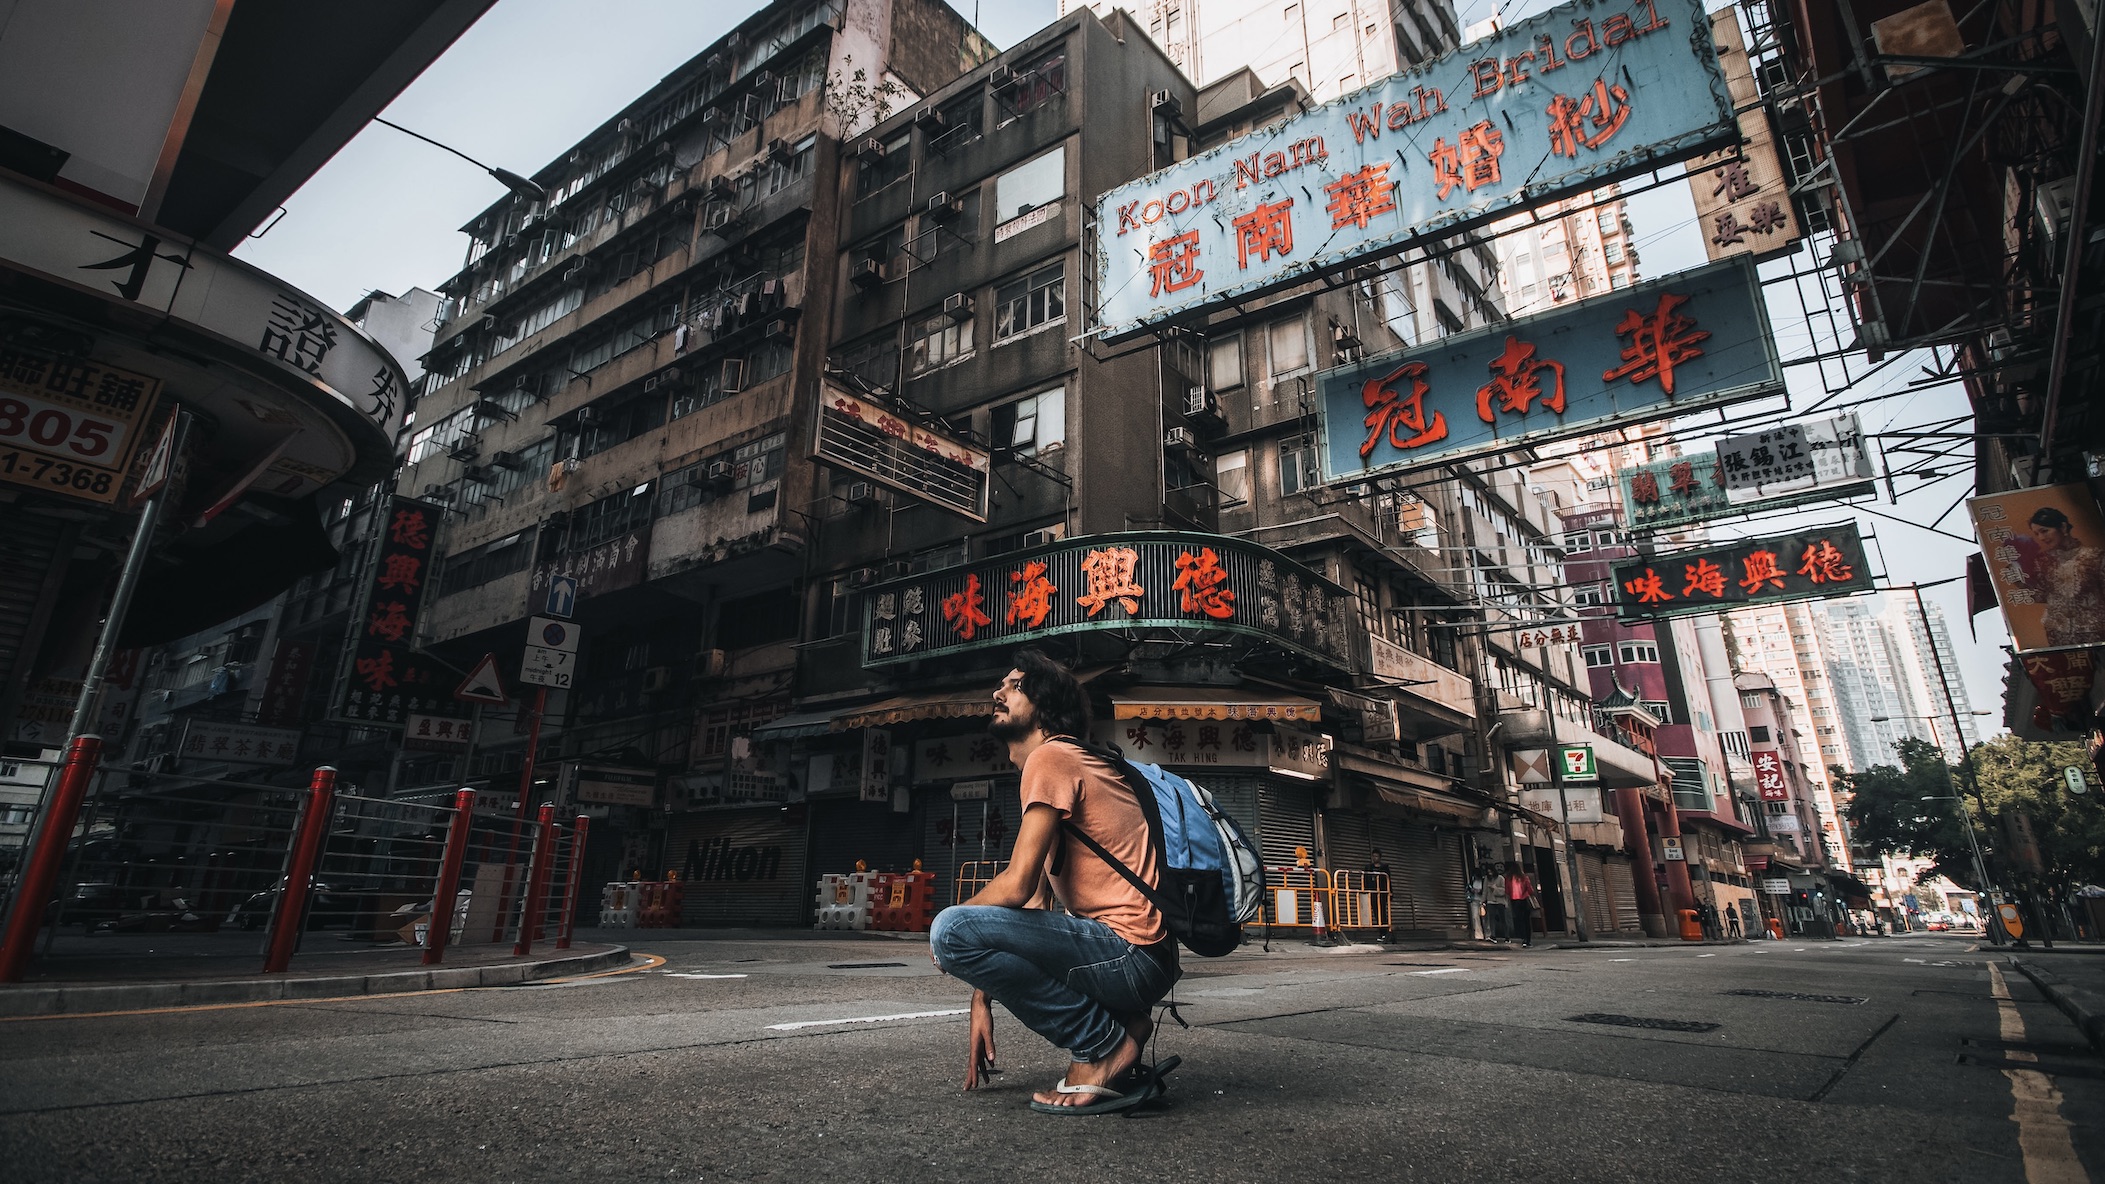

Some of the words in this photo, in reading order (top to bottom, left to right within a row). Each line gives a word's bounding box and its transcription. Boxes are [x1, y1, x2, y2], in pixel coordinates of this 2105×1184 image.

[1115, 178, 1217, 237] Koon
[1233, 134, 1329, 190] Nam
[1346, 84, 1449, 144] Wah
[1467, 0, 1670, 99] Bridal
[1358, 292, 1713, 459] 冠南華
[558, 653, 567, 665] 7
[554, 673, 570, 686] 12
[1168, 752, 1186, 764] TAK
[1193, 752, 1218, 763] HING
[681, 837, 782, 882] Nikon
